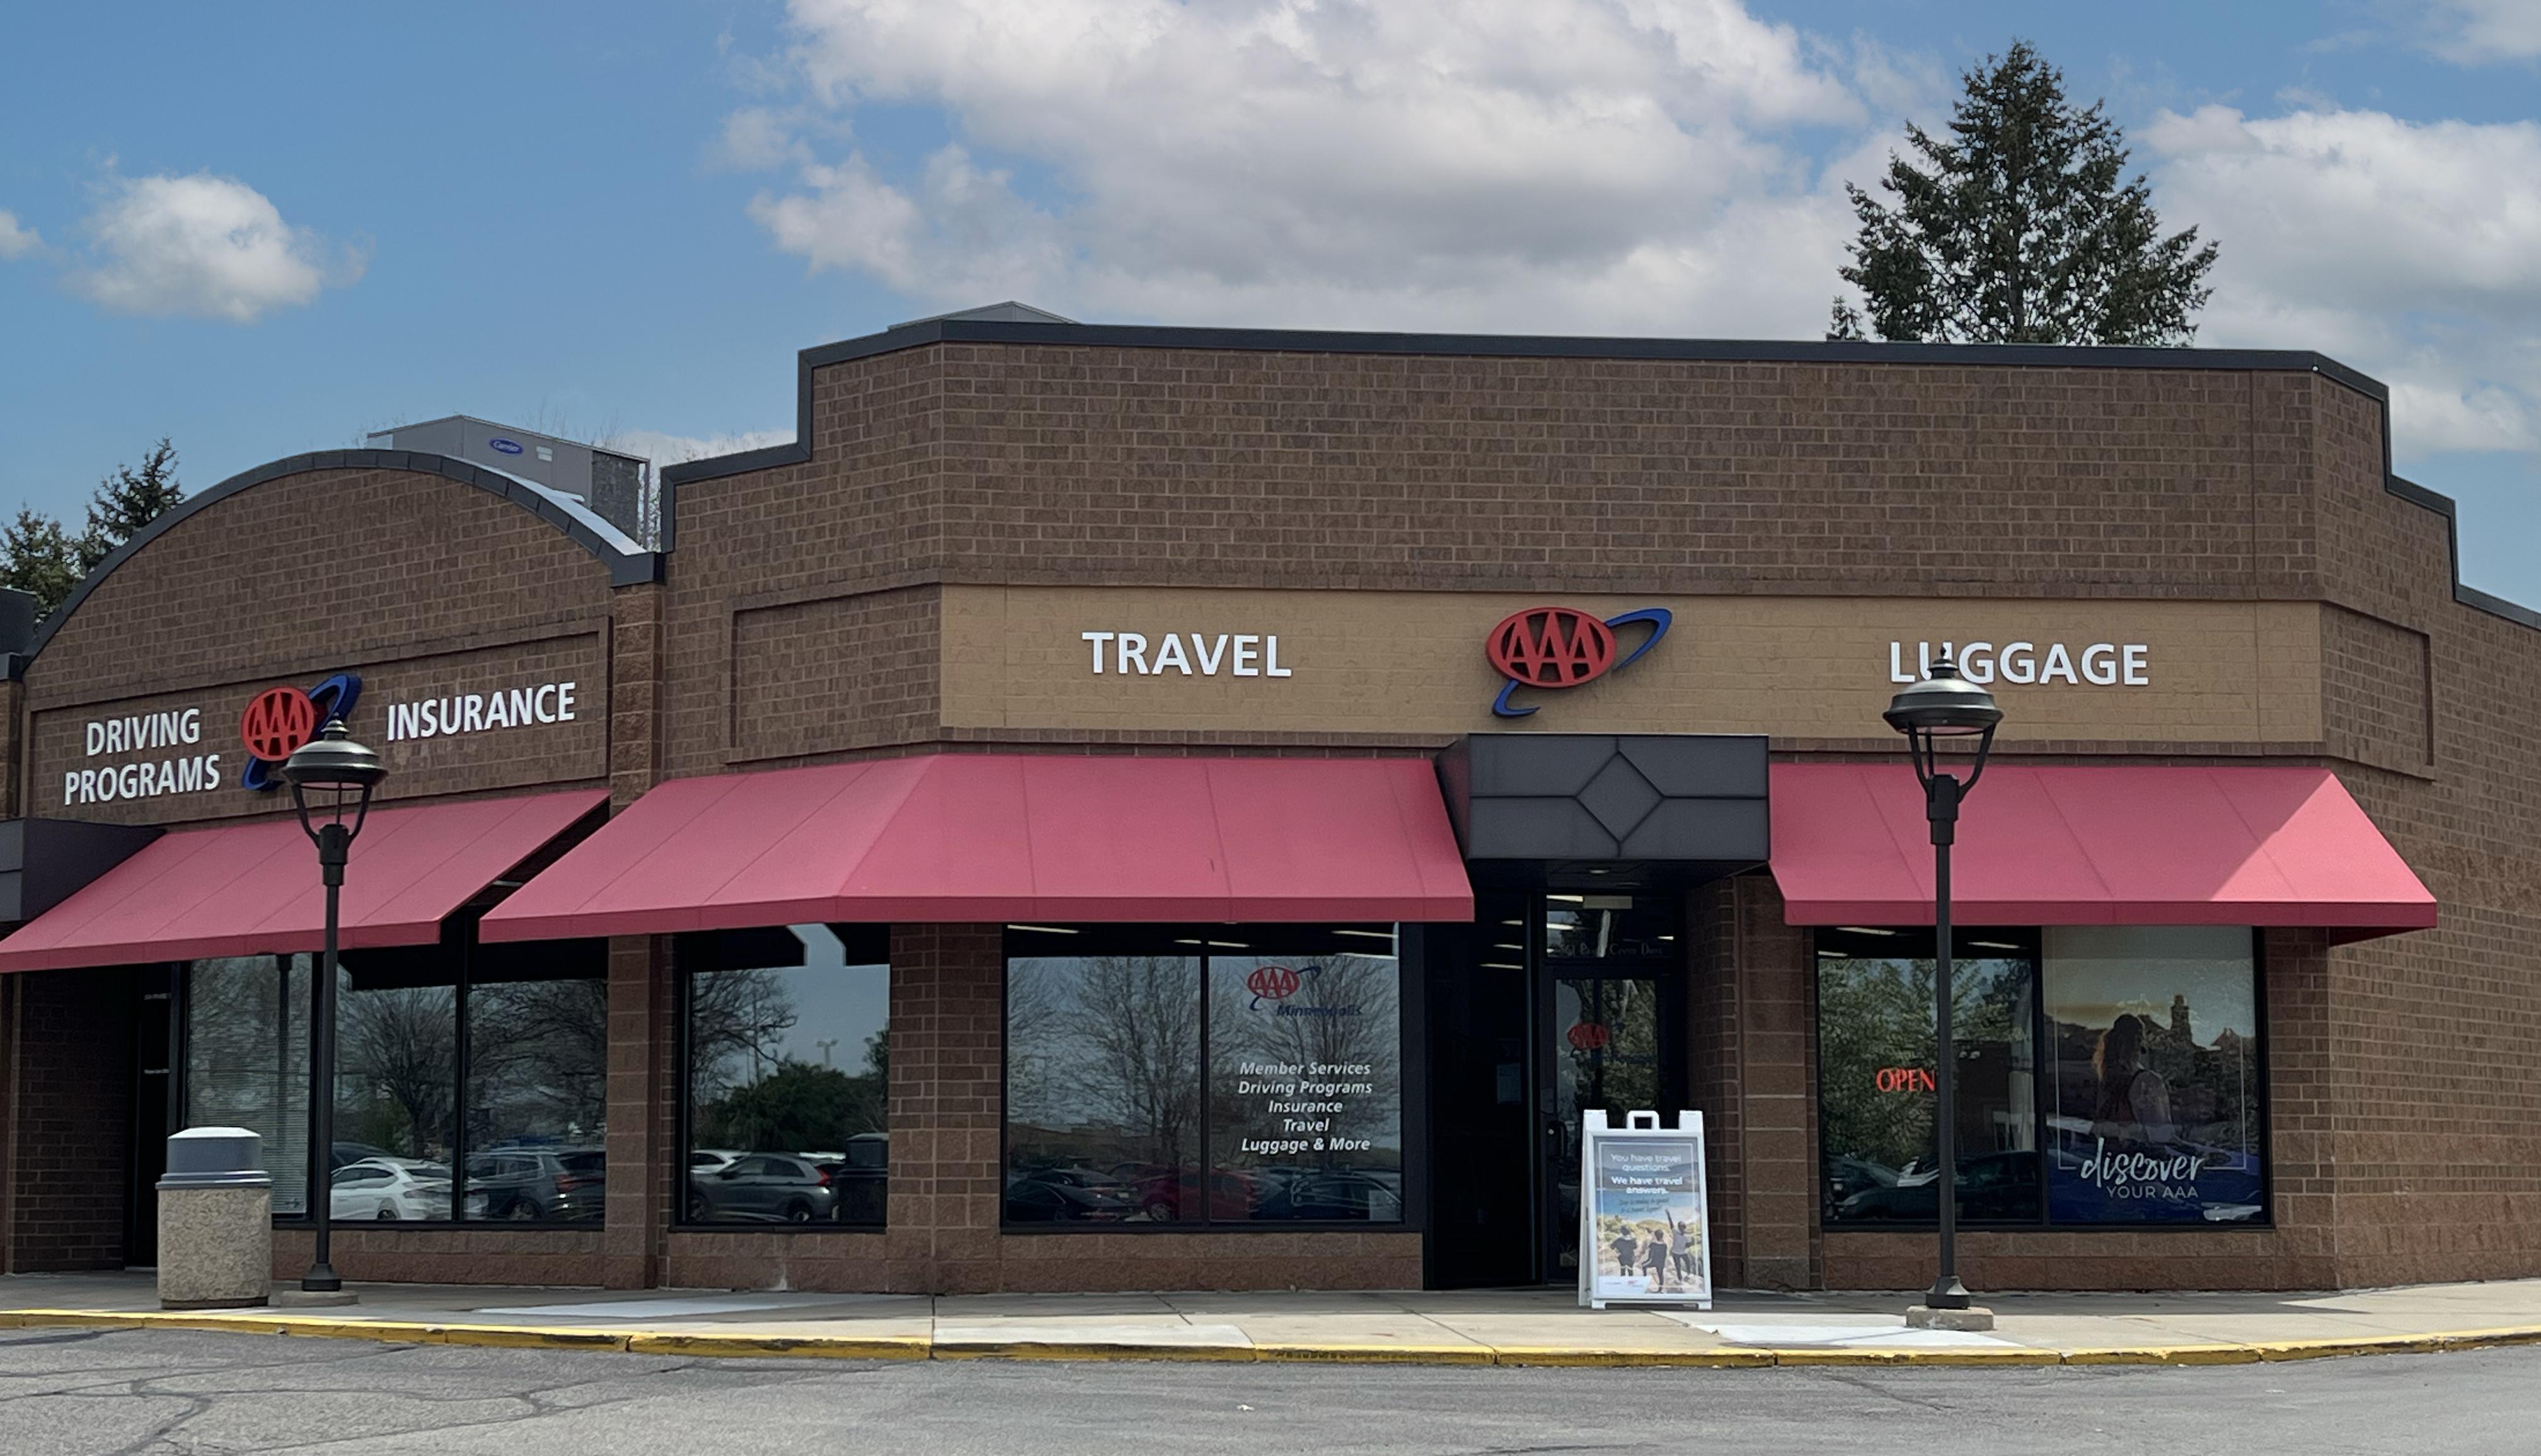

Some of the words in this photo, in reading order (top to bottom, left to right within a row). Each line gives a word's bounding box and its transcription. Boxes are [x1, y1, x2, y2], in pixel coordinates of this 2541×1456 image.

[1081, 632, 1291, 677] TRAVEL
[1487, 609, 1616, 688] AAA
[1891, 641, 2148, 685] LUGGAGE
[244, 687, 313, 760] AAA
[387, 682, 576, 742] INSURANCE
[86, 708, 200, 757] DRIVING
[64, 754, 221, 806] PROGRAMS
[1248, 966, 1299, 999] AAA
[1240, 1062, 1305, 1075] Member
[1309, 1062, 1371, 1075] Services
[1876, 1067, 1935, 1092] OPEN
[1238, 1080, 1295, 1097] Driving
[1299, 1081, 1373, 1097] Programs
[1268, 1100, 1343, 1113] Insurance
[1283, 1118, 1330, 1132] Travel
[1242, 1138, 1308, 1154] Luggage
[1313, 1137, 1325, 1151] &
[1329, 1137, 1371, 1151] More
[1611, 1154, 1628, 1162] You
[1631, 1154, 1653, 1162] have
[1655, 1154, 1681, 1162] travel
[2080, 1137, 2204, 1188] discover
[1611, 1176, 1628, 1184] We
[1630, 1176, 1652, 1184] have
[1655, 1176, 1683, 1185] travel
[2106, 1186, 2155, 1198] YOUR
[2162, 1186, 2198, 1198] AAA
